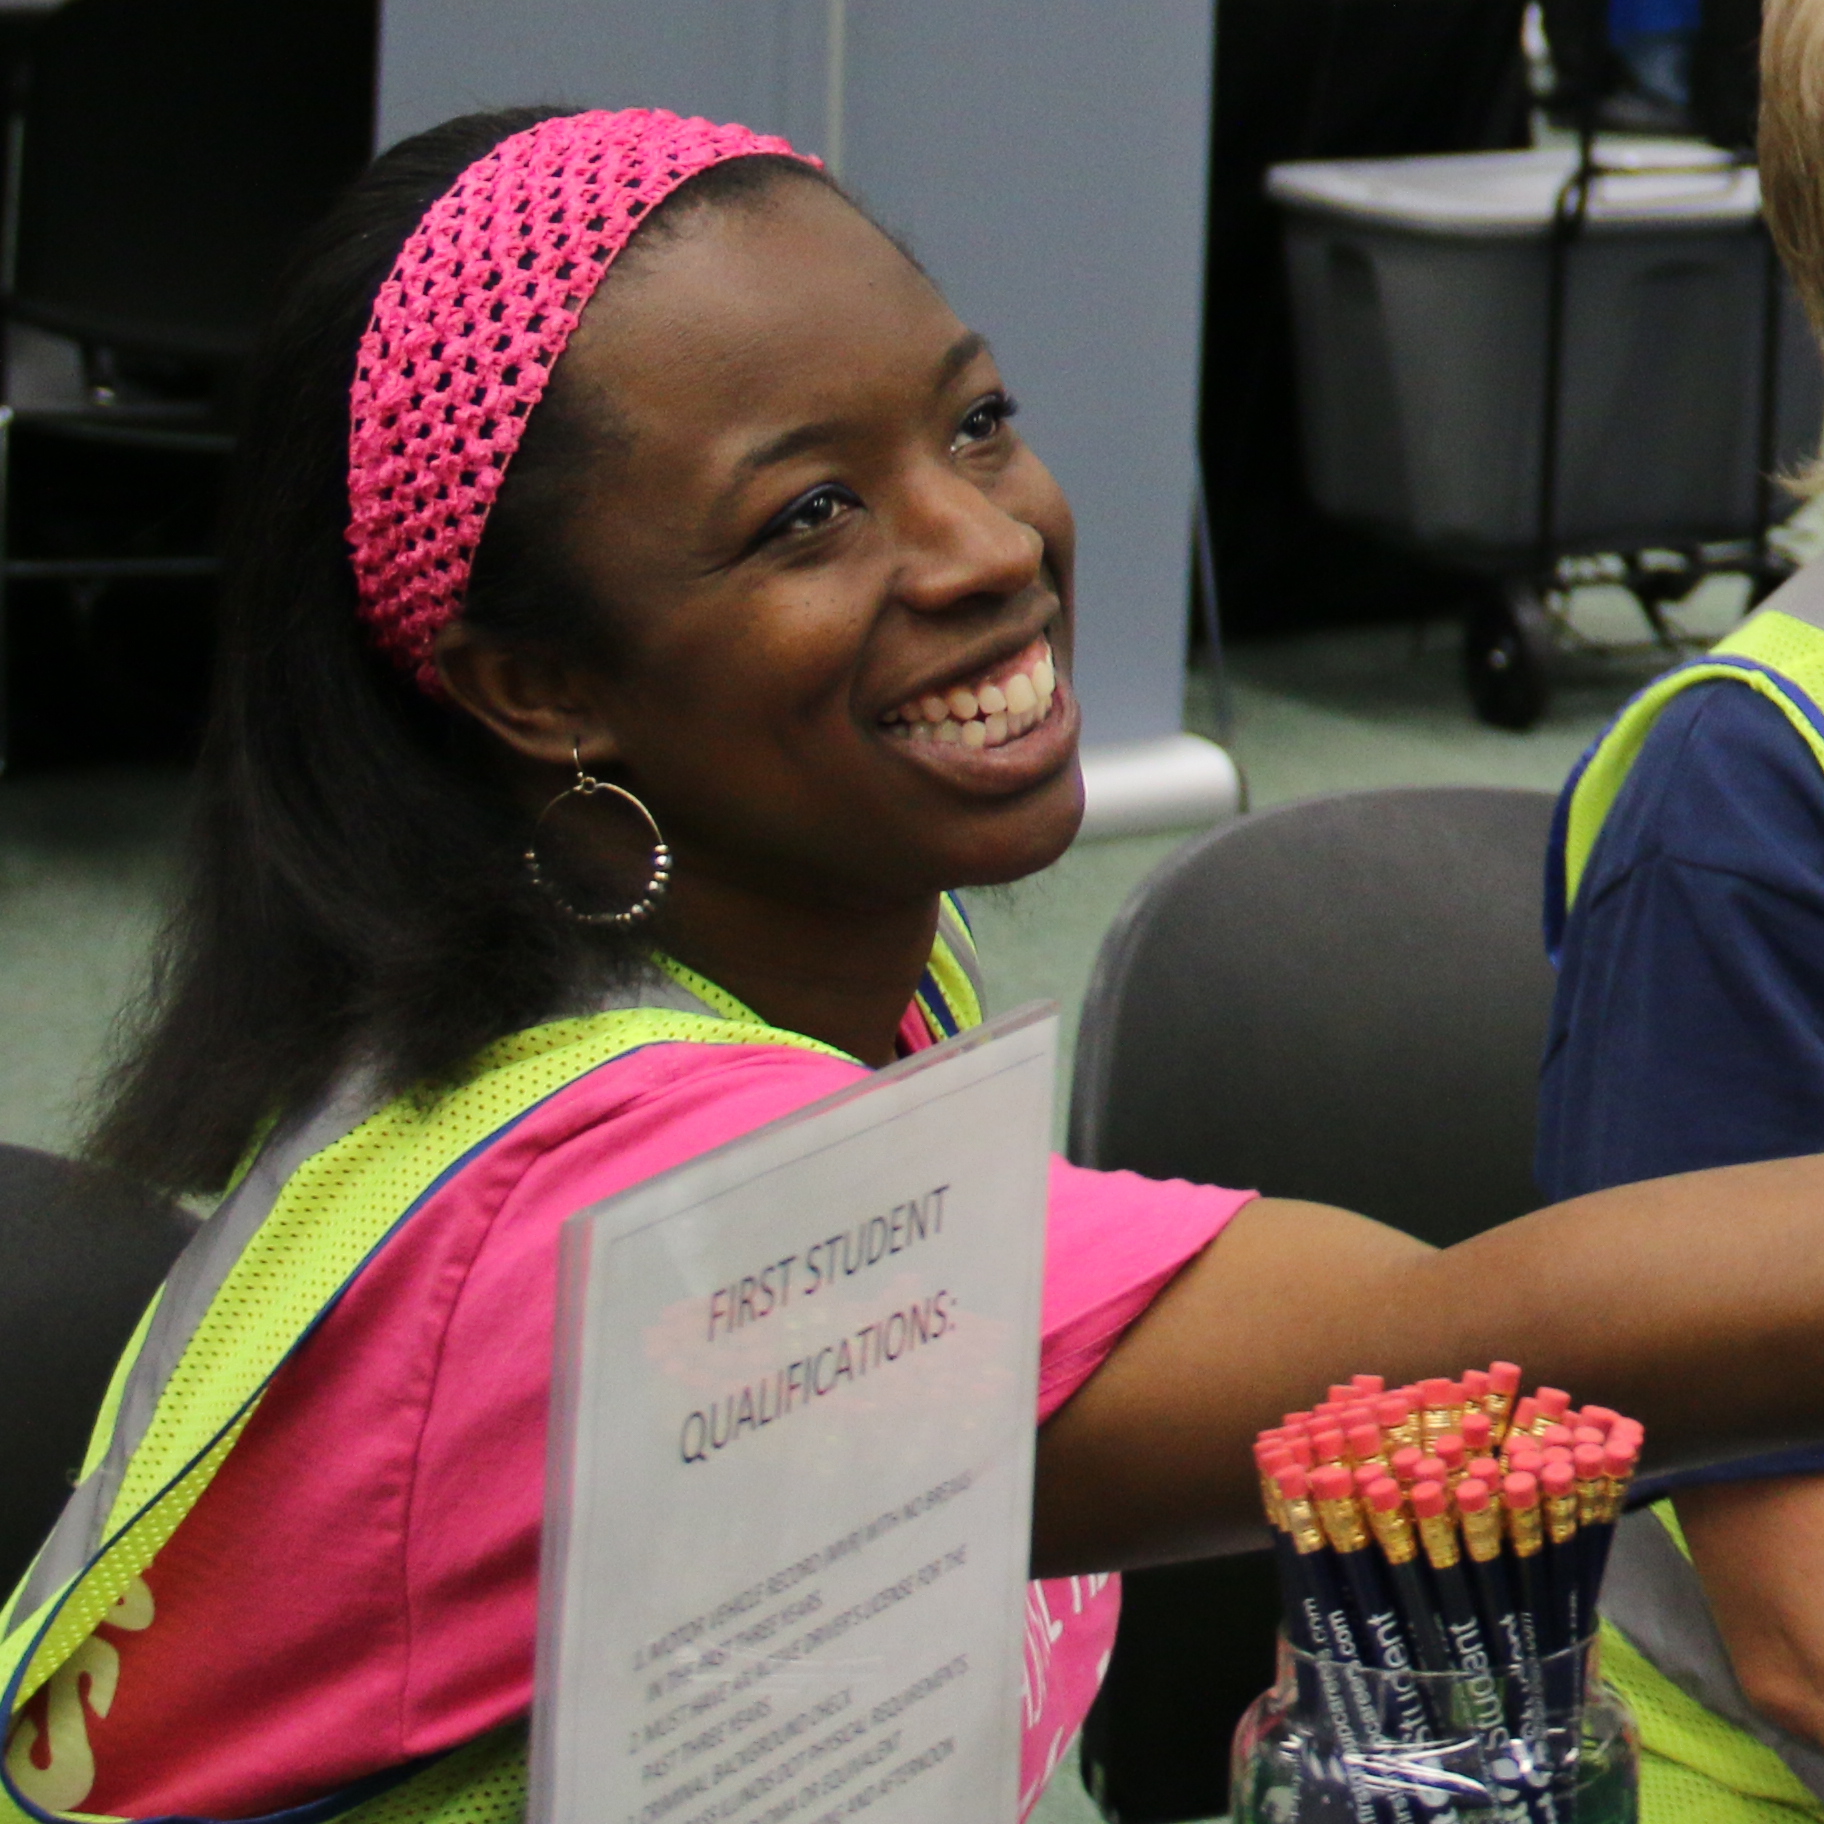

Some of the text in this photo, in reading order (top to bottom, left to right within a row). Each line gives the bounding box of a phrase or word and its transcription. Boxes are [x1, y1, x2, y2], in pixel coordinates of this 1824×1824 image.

[707, 1184, 950, 1343] FIRST STUDENT
[680, 1290, 958, 1464] QUALIFICATIONS:
